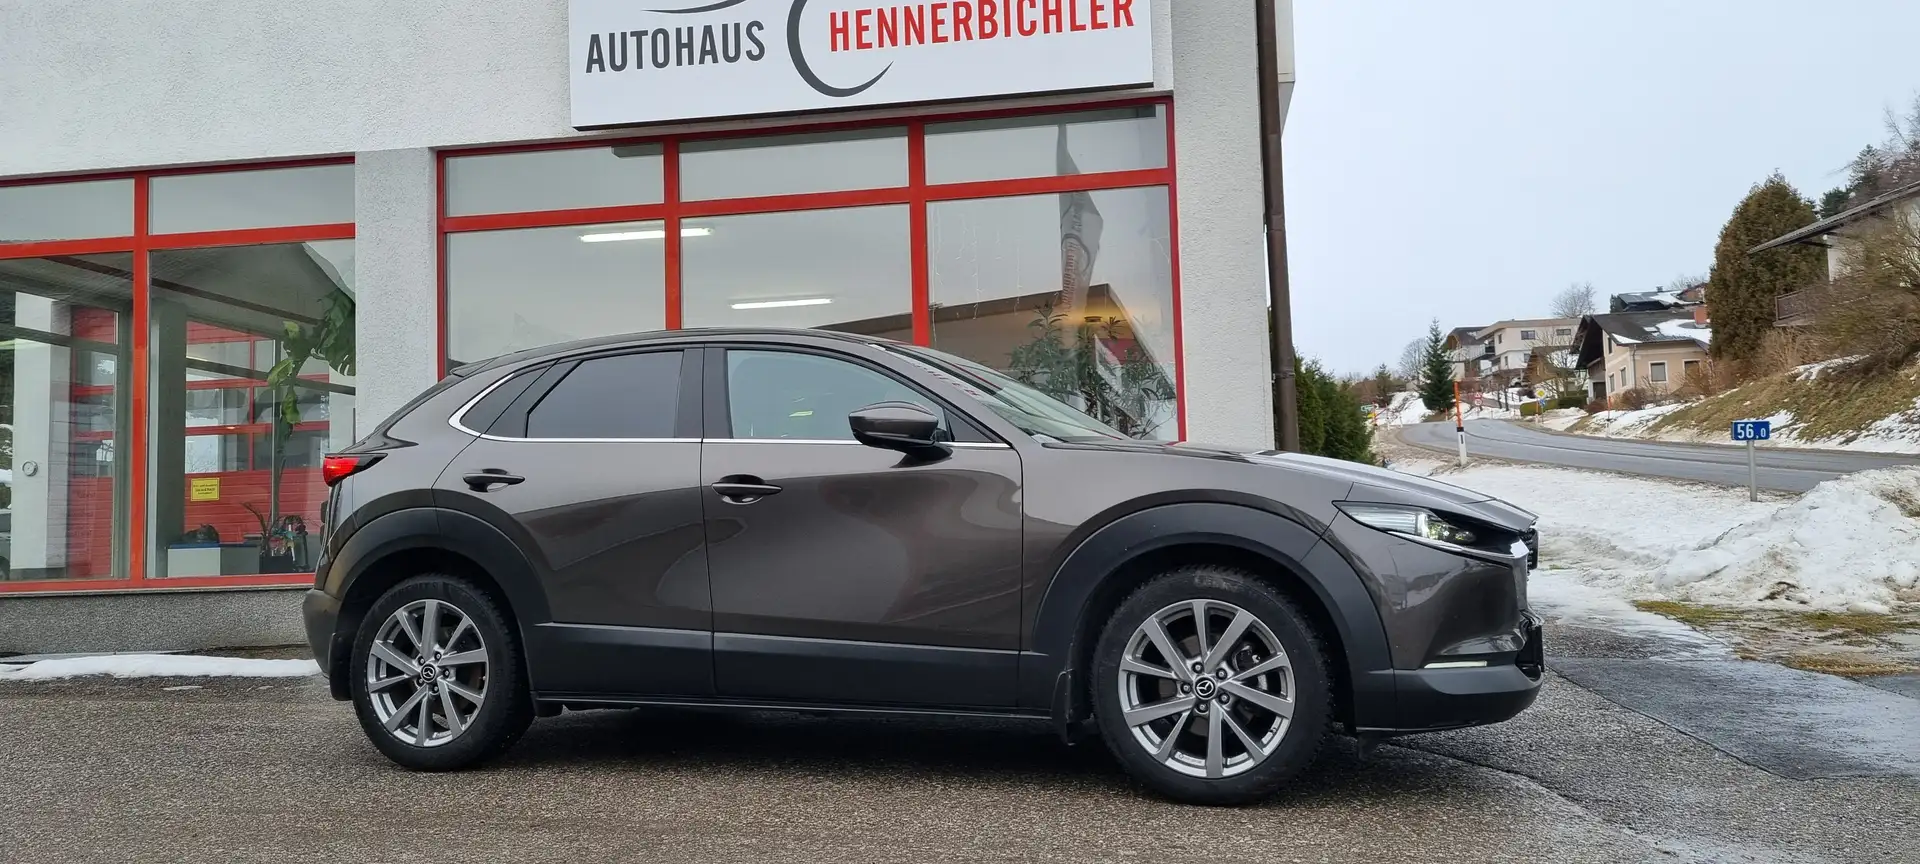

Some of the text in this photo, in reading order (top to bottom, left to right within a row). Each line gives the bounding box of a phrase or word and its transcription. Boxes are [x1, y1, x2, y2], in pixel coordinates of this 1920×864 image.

[585, 0, 1135, 74] AUTOHAUS HENNERBICHLER
[1737, 423, 1767, 439] 56,0
